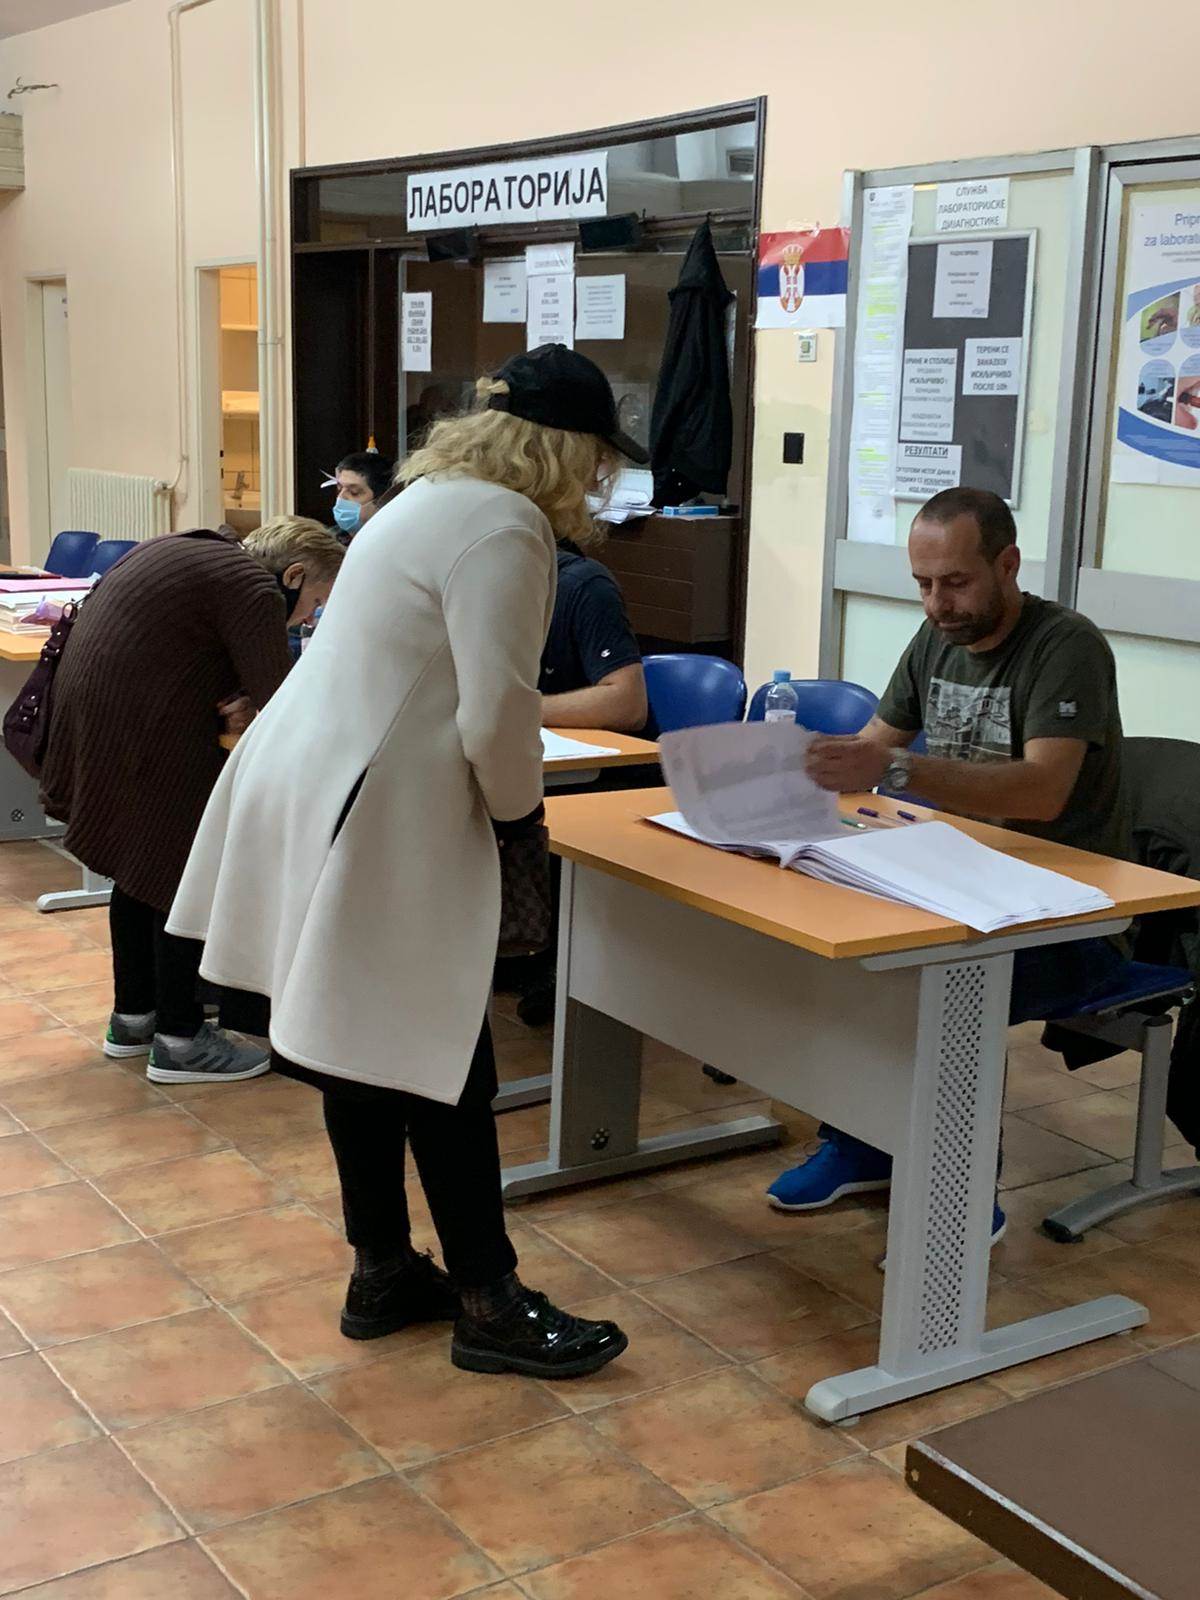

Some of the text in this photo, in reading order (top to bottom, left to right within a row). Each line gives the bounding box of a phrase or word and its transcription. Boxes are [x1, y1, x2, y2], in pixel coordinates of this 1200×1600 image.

[409, 167, 605, 219] ЛАБОРАТОРИЈА
[956, 184, 988, 197] СЛУЖБА
[941, 215, 1000, 230] ДИЈАГНОСТИКЕ
[1144, 236, 1157, 247] za
[904, 445, 949, 459] РЕЗУЛТАТИ
